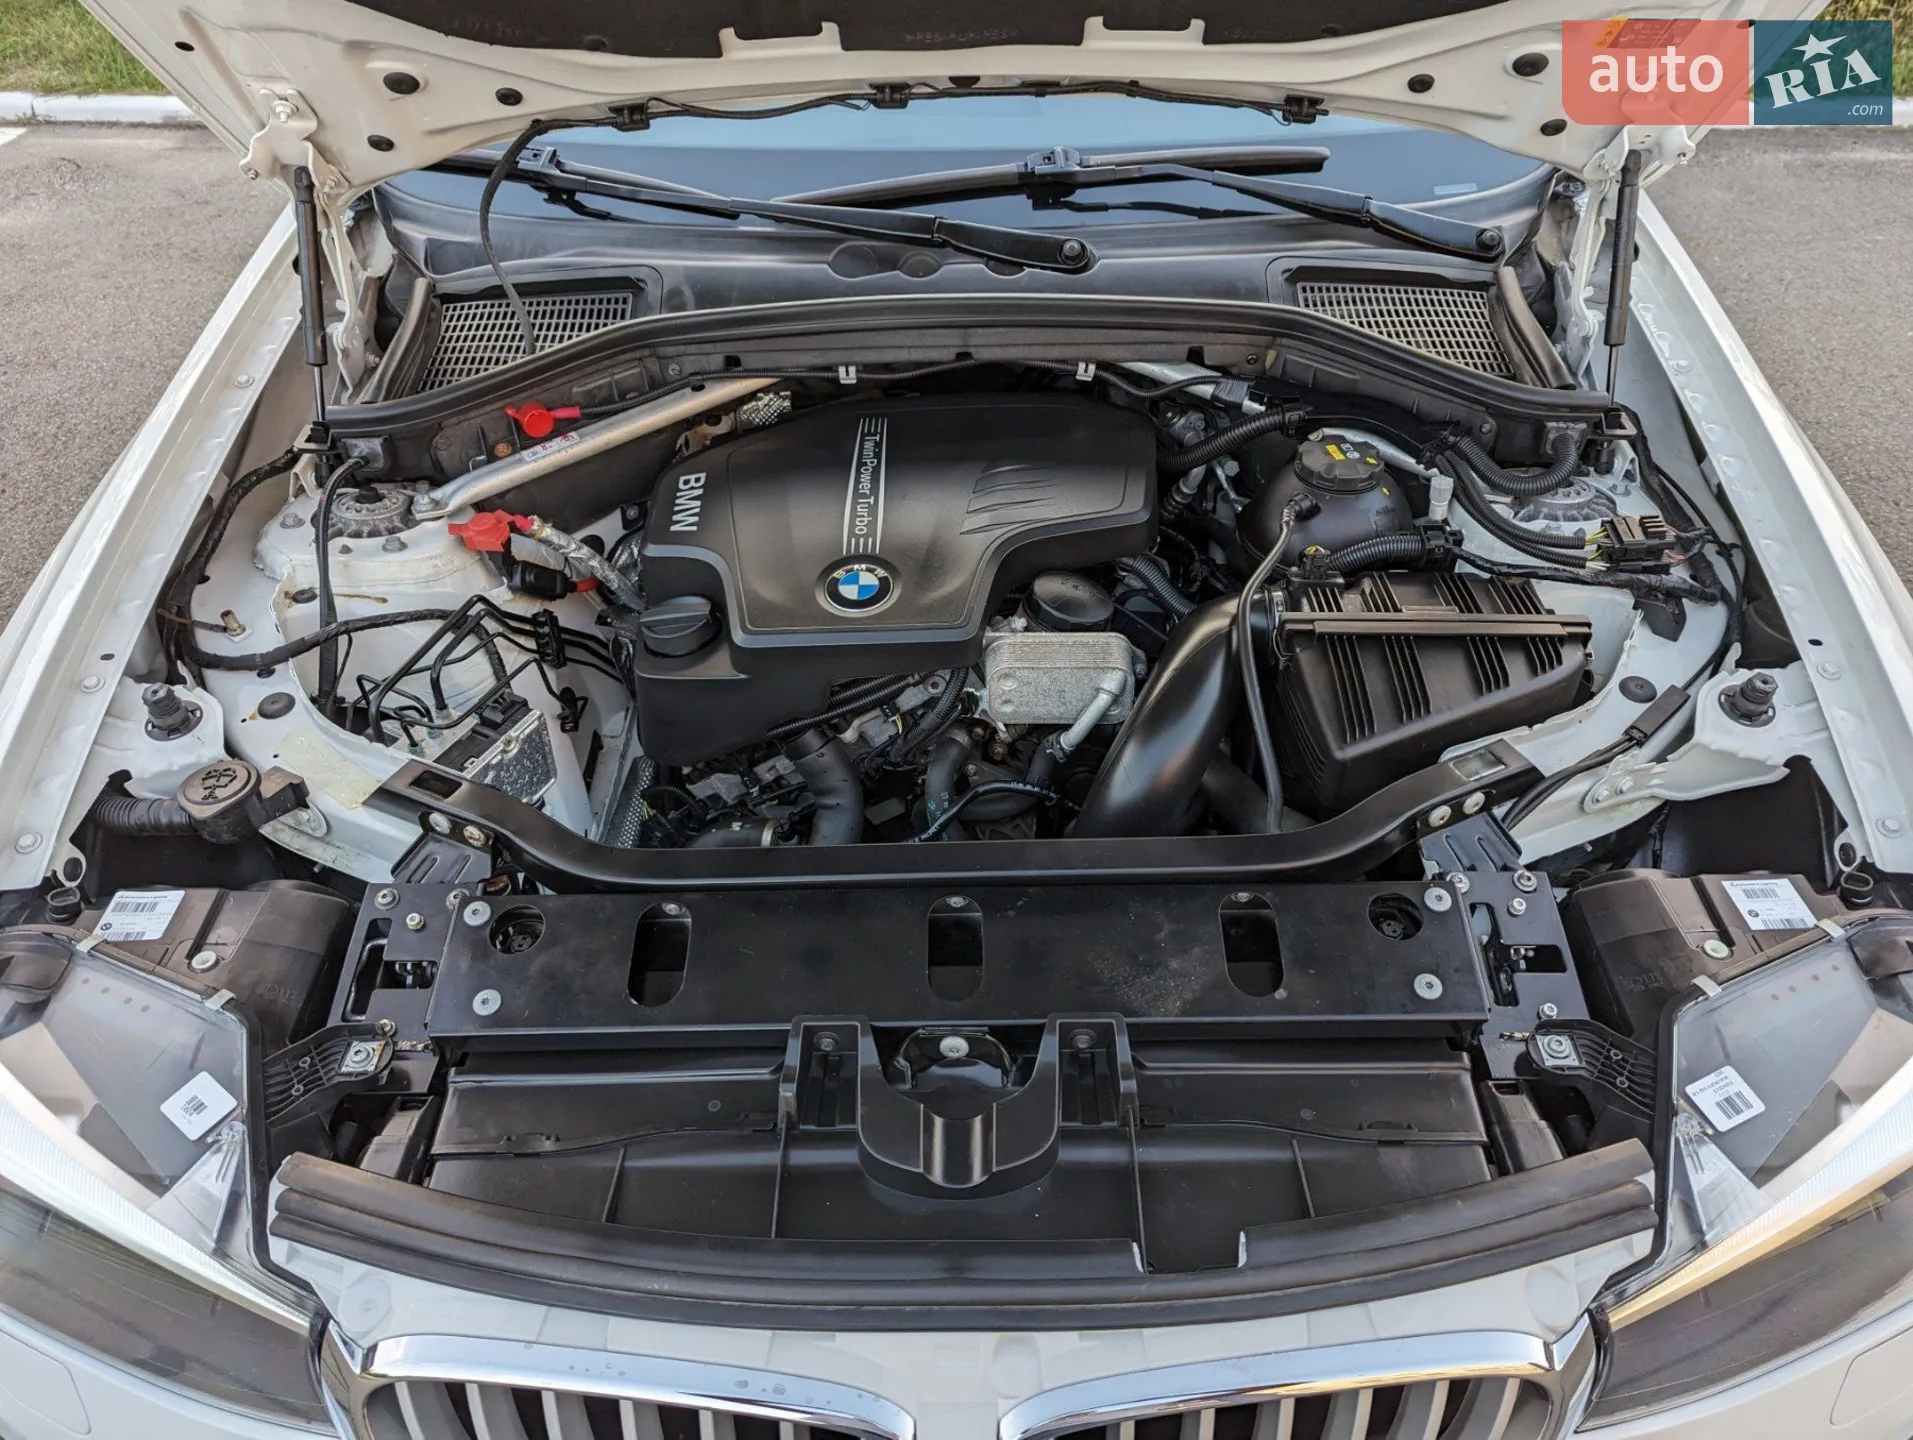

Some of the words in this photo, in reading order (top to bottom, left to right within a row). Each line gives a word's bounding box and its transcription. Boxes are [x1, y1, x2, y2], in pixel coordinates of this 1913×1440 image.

[858, 433, 881, 495] TwinPower
[669, 472, 707, 532] BMW
[855, 496, 875, 535] Turbo
[833, 564, 888, 579] BMW
